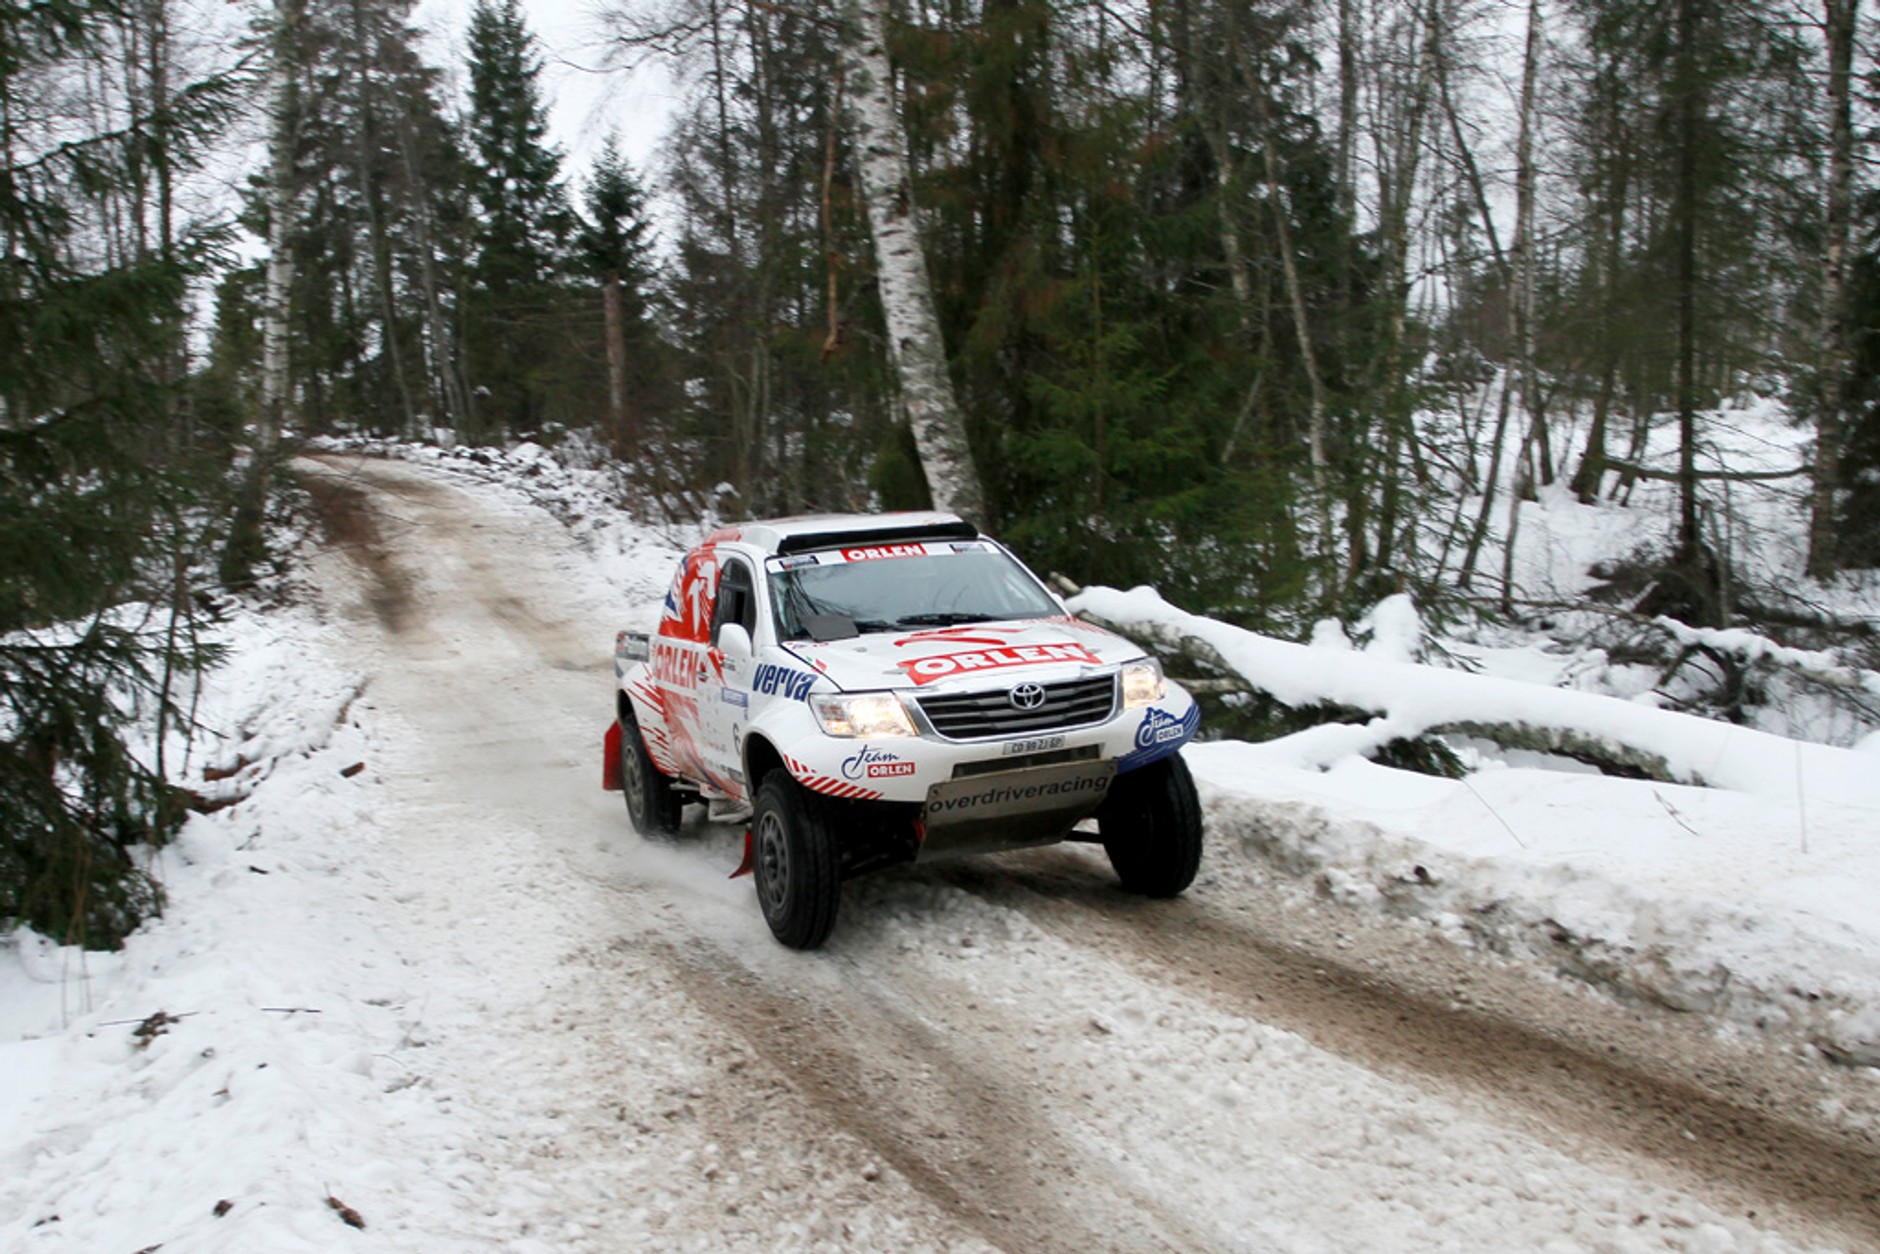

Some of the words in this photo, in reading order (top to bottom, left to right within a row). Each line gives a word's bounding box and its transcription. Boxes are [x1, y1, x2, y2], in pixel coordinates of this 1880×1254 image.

[848, 543, 923, 561] ORLEN
[655, 644, 699, 690] ORLEN
[914, 643, 1087, 674] ORLEN
[752, 663, 818, 702] verva
[870, 764, 912, 776] ORLEN
[929, 776, 1108, 813] overdriveracing
